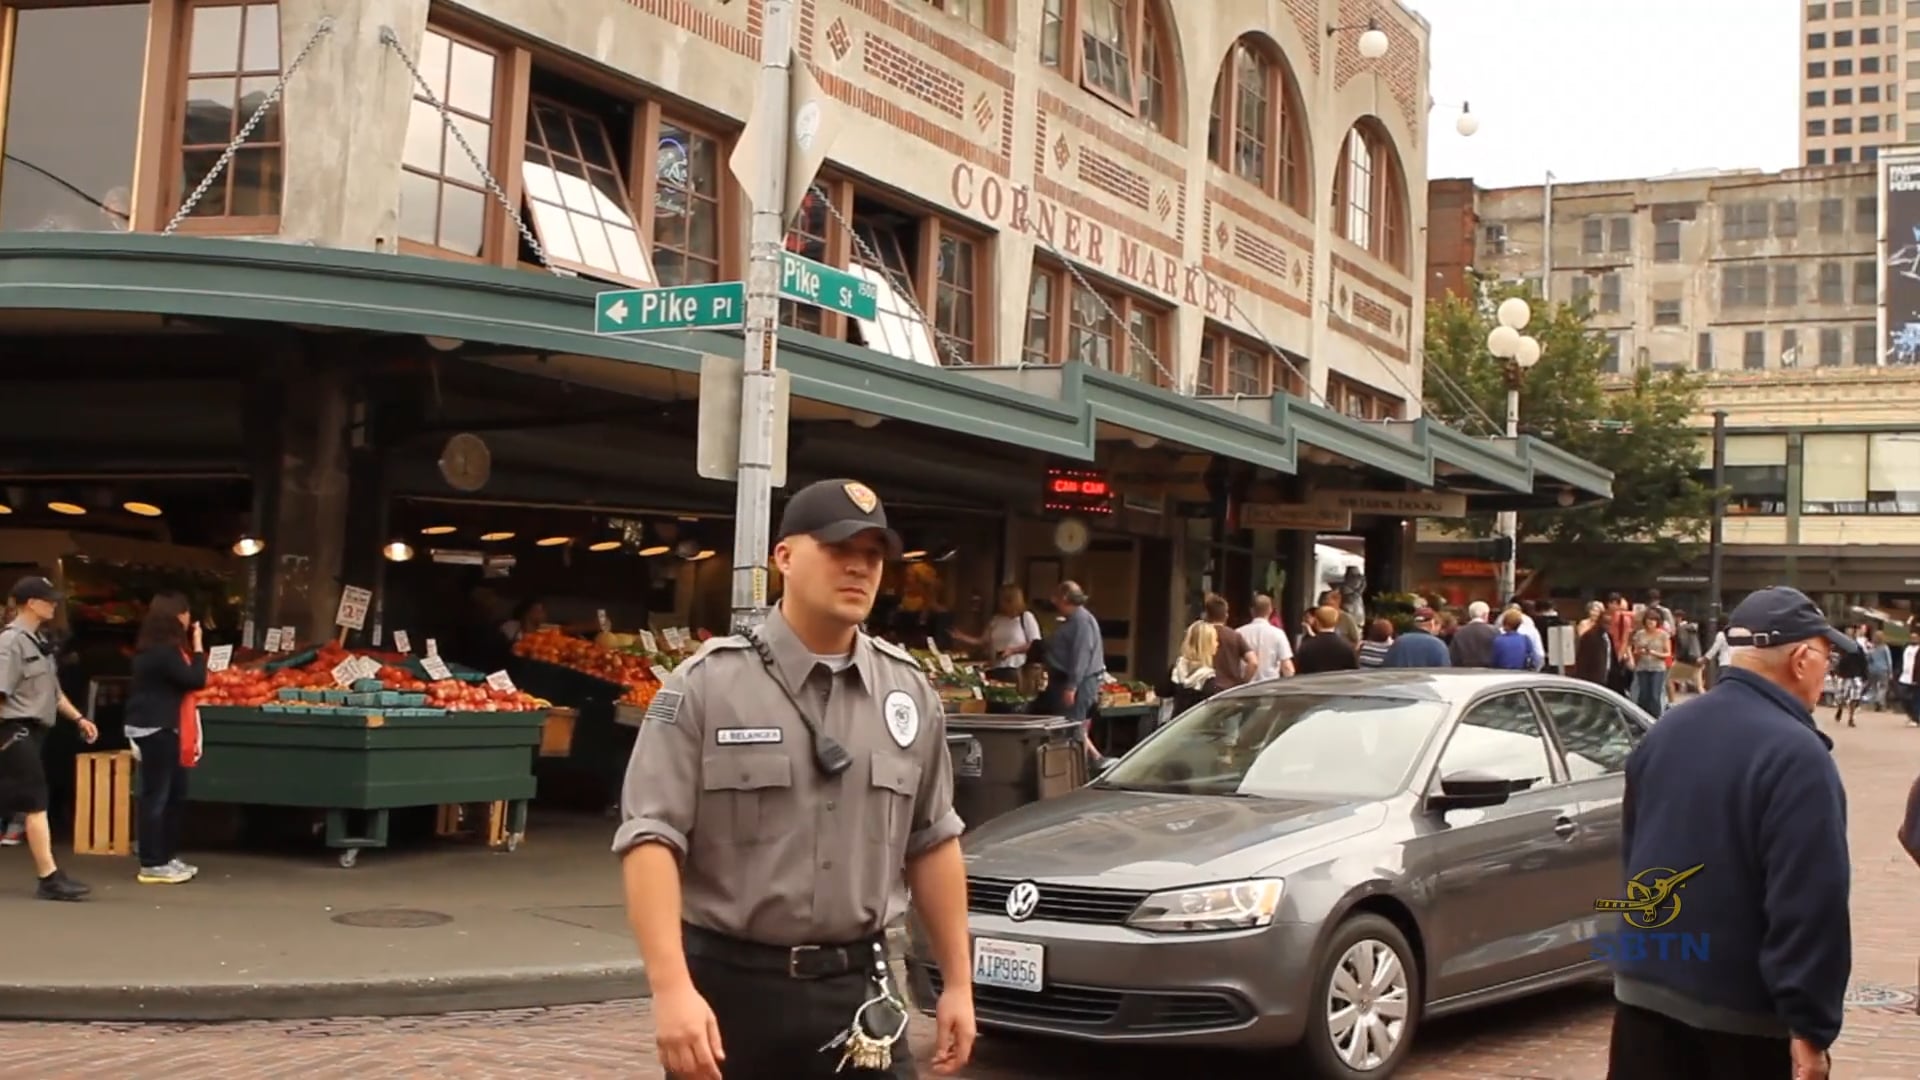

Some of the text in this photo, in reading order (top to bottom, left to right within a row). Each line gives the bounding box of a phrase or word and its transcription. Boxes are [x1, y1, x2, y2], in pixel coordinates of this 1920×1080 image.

[952, 162, 1236, 321] CORNER MARKET
[641, 293, 732, 324] Pike Pl
[783, 257, 820, 298] Pike
[839, 286, 853, 309] St
